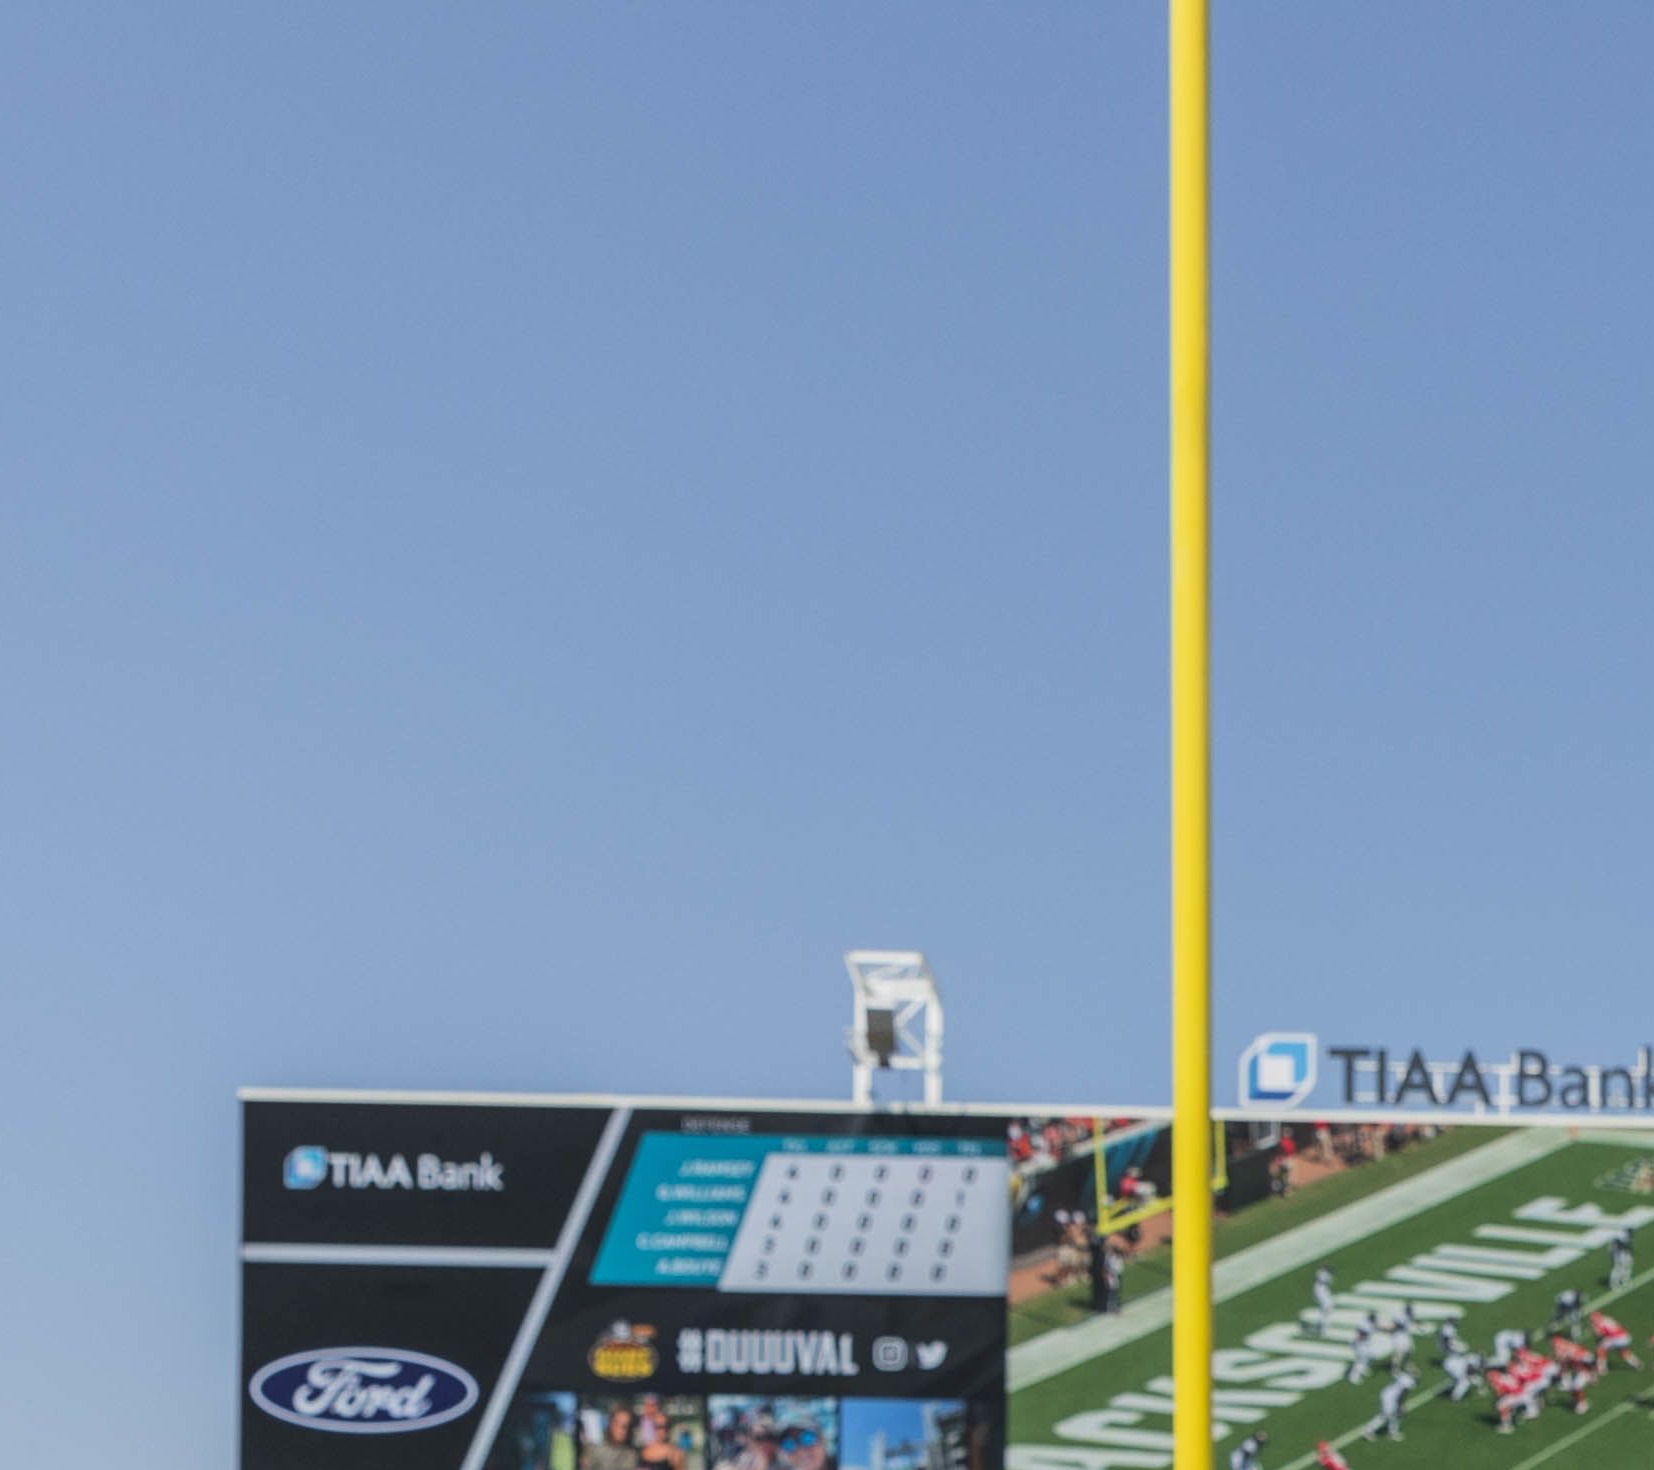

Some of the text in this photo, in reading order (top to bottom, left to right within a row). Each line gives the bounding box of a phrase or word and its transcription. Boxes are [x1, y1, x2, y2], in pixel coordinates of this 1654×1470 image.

[1328, 1047, 1492, 1110] TIAA
[327, 1152, 503, 1192] TIAA Bank
[677, 1327, 859, 1377] #DUUUVAL
[292, 1358, 433, 1421] Ford
